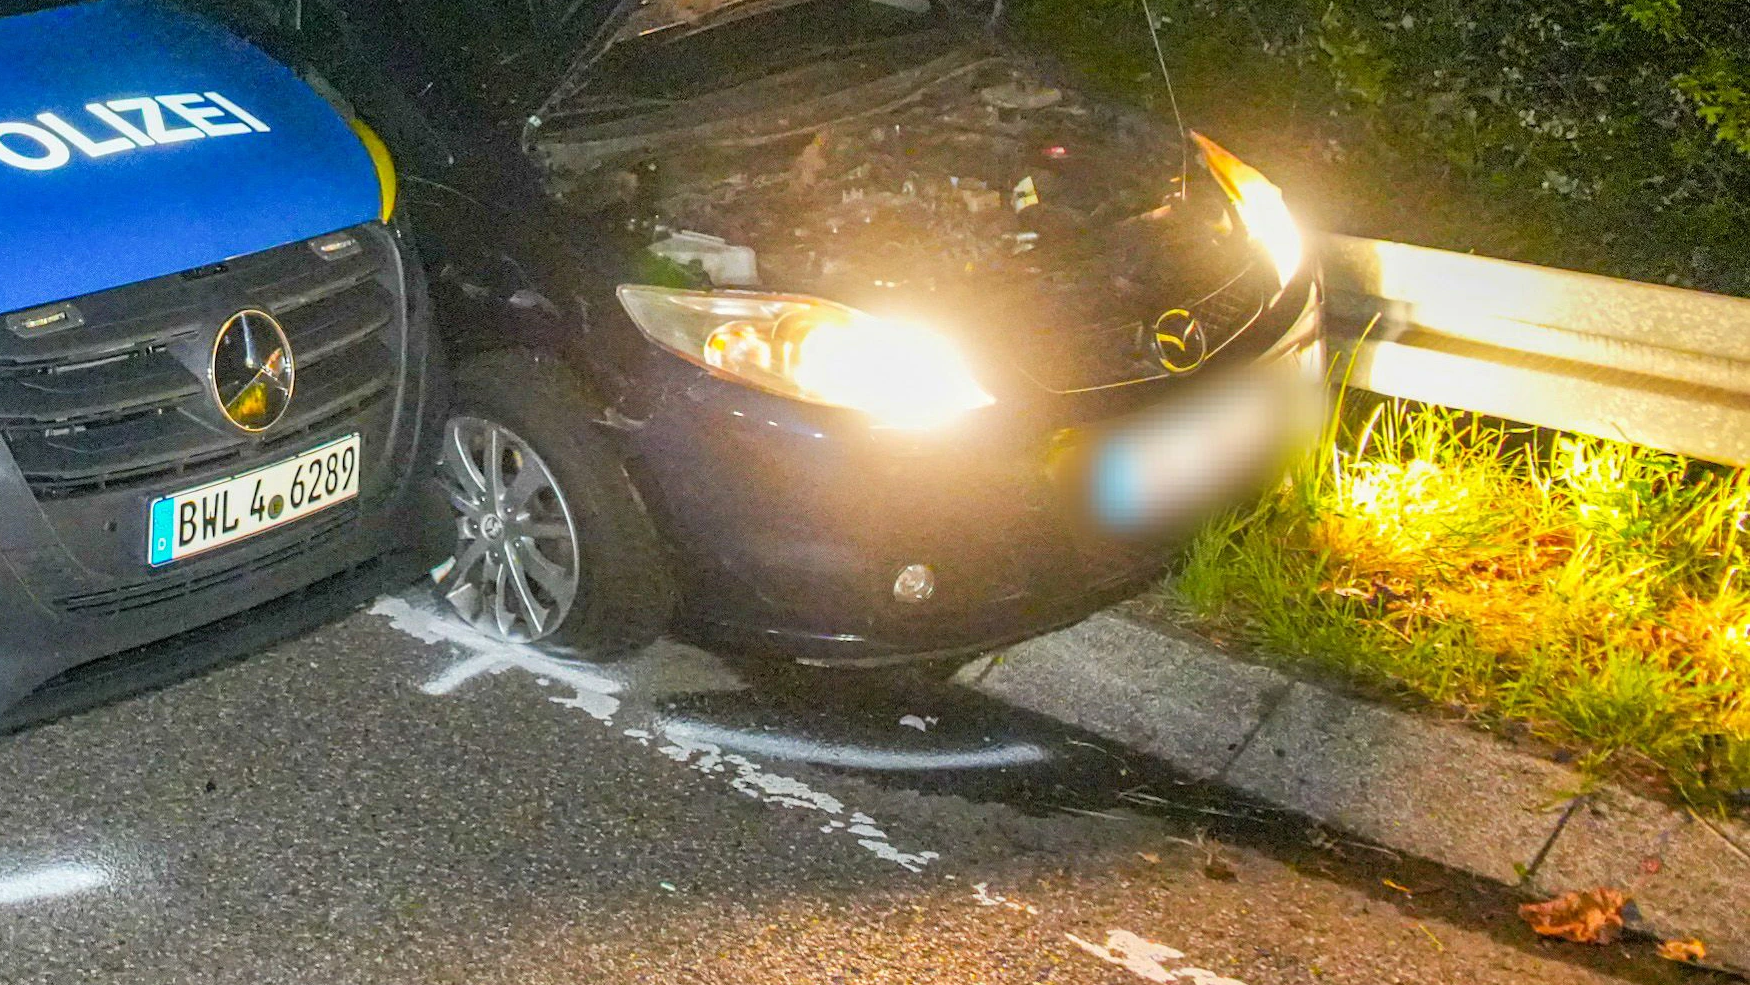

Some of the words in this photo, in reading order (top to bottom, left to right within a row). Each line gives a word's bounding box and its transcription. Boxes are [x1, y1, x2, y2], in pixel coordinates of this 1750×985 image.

[179, 490, 239, 547] BWL
[250, 479, 266, 522] 4
[290, 446, 354, 509] 6289
